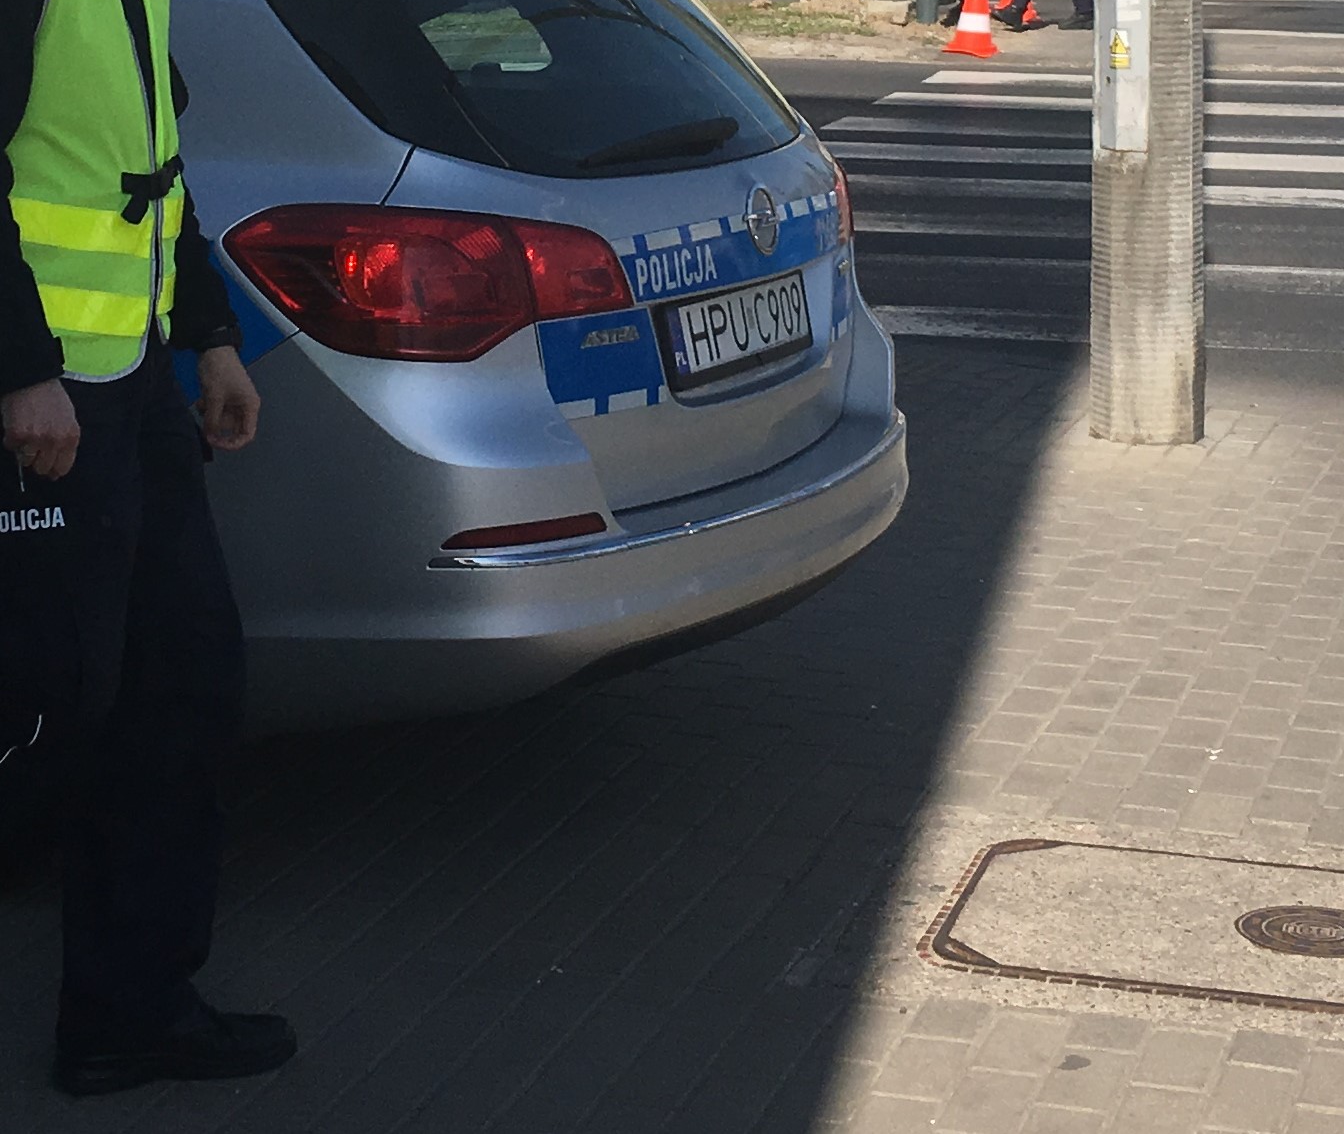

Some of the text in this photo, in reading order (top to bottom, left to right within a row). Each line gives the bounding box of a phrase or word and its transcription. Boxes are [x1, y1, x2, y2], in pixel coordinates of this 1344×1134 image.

[635, 244, 718, 296] POLICJA
[687, 281, 805, 366] HPU C909
[675, 352, 688, 367] PL
